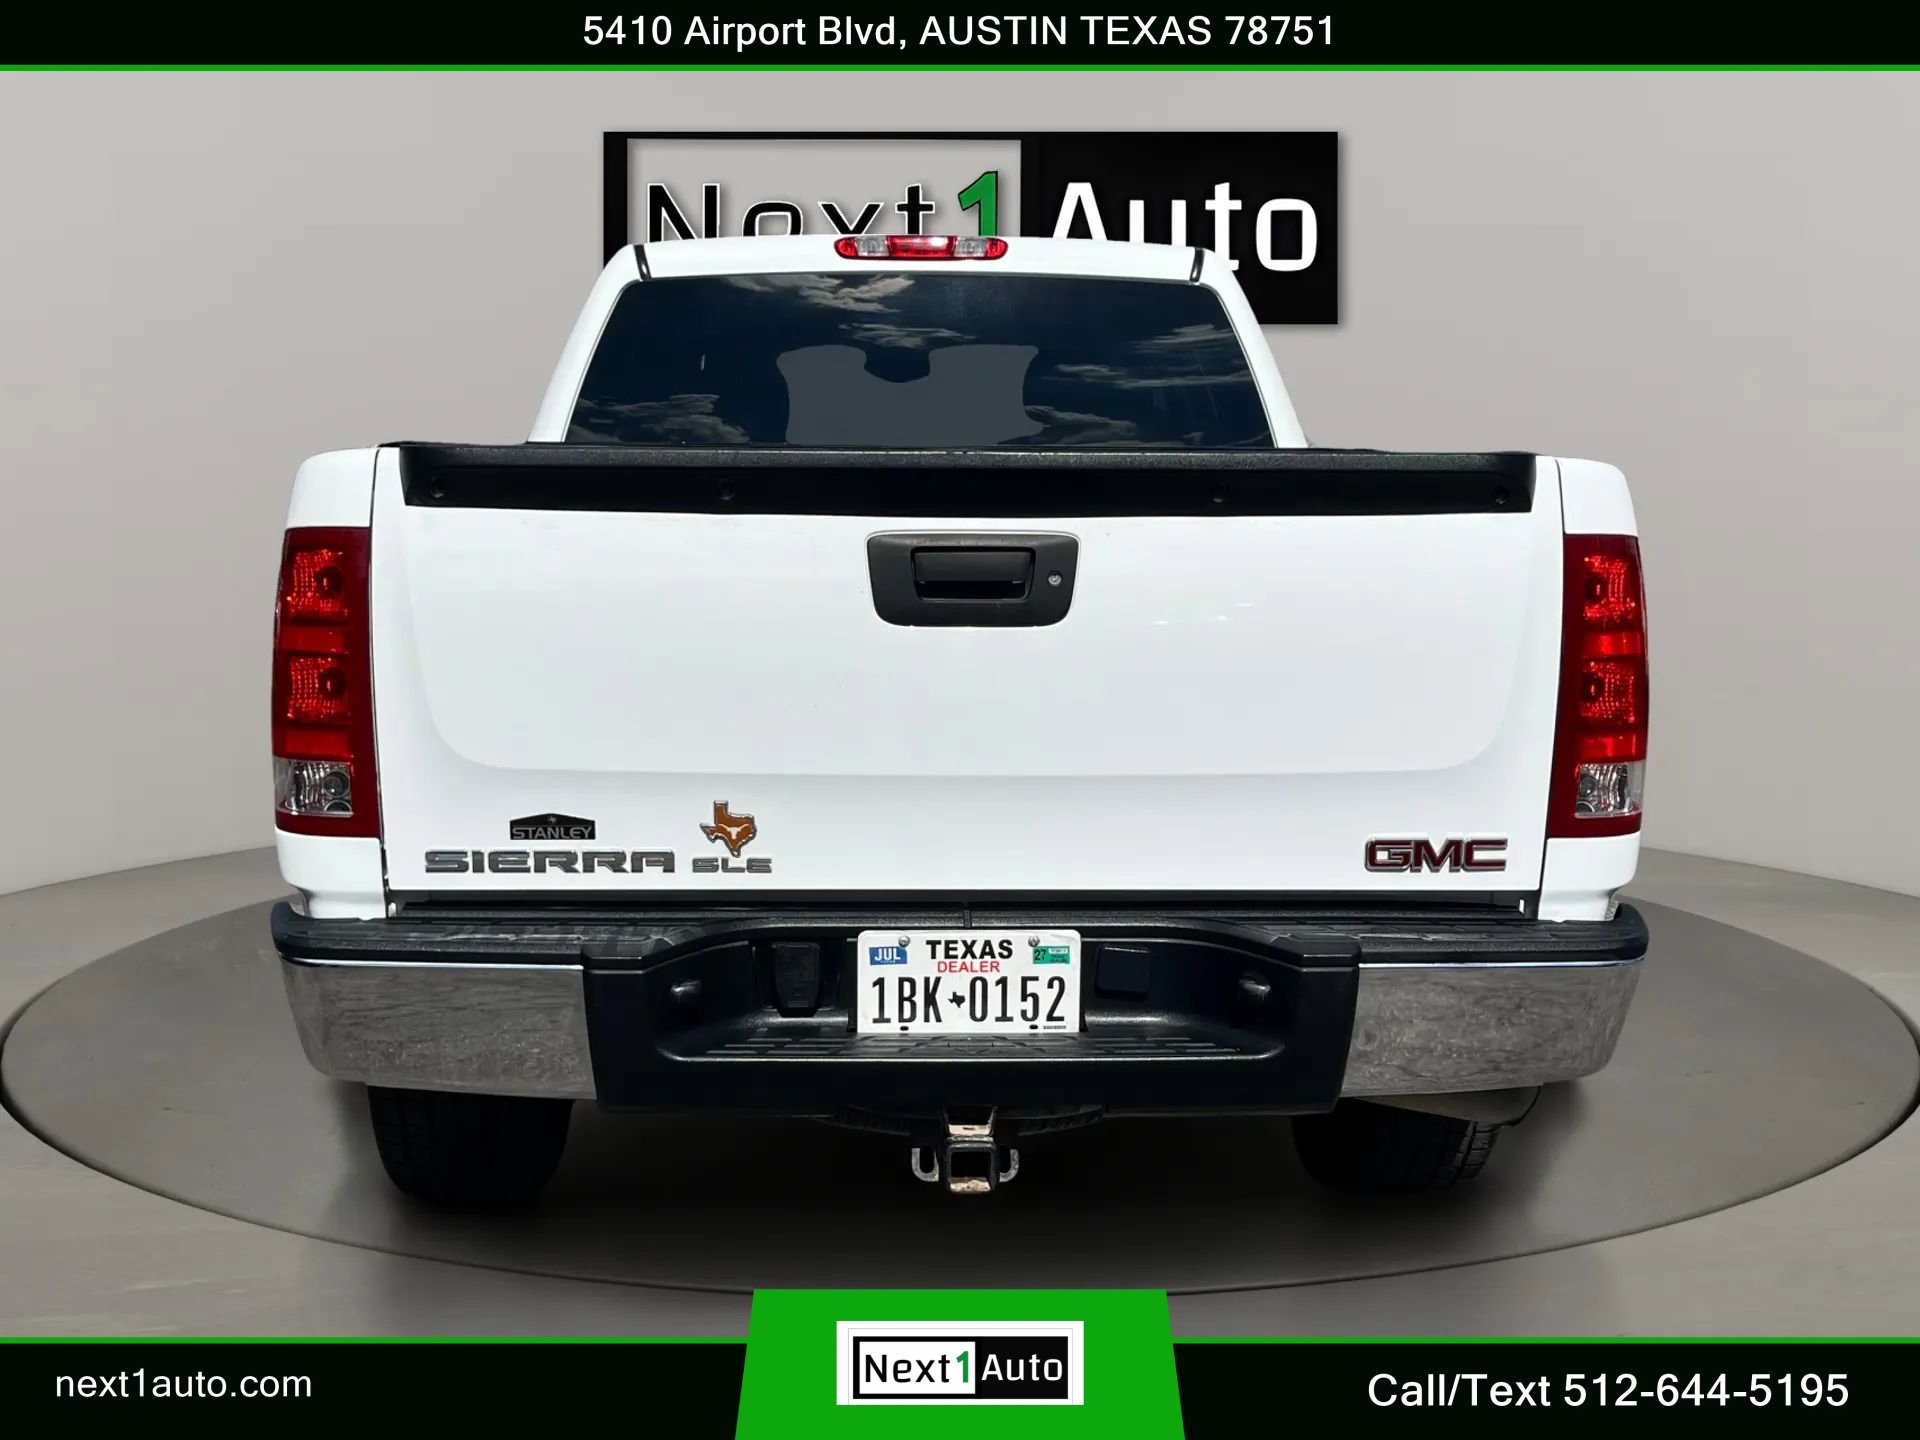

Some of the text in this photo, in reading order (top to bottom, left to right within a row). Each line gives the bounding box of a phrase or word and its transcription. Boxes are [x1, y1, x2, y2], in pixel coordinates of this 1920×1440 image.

[1051, 182, 1318, 272] Auto
[511, 825, 593, 840] STANLEY
[425, 849, 772, 874] SIERRA SLE
[1365, 838, 1508, 873] GMC
[874, 947, 901, 961] JUL
[926, 939, 1013, 960] TEXAS
[1034, 948, 1047, 961] 27
[937, 961, 1001, 973] DEALER
